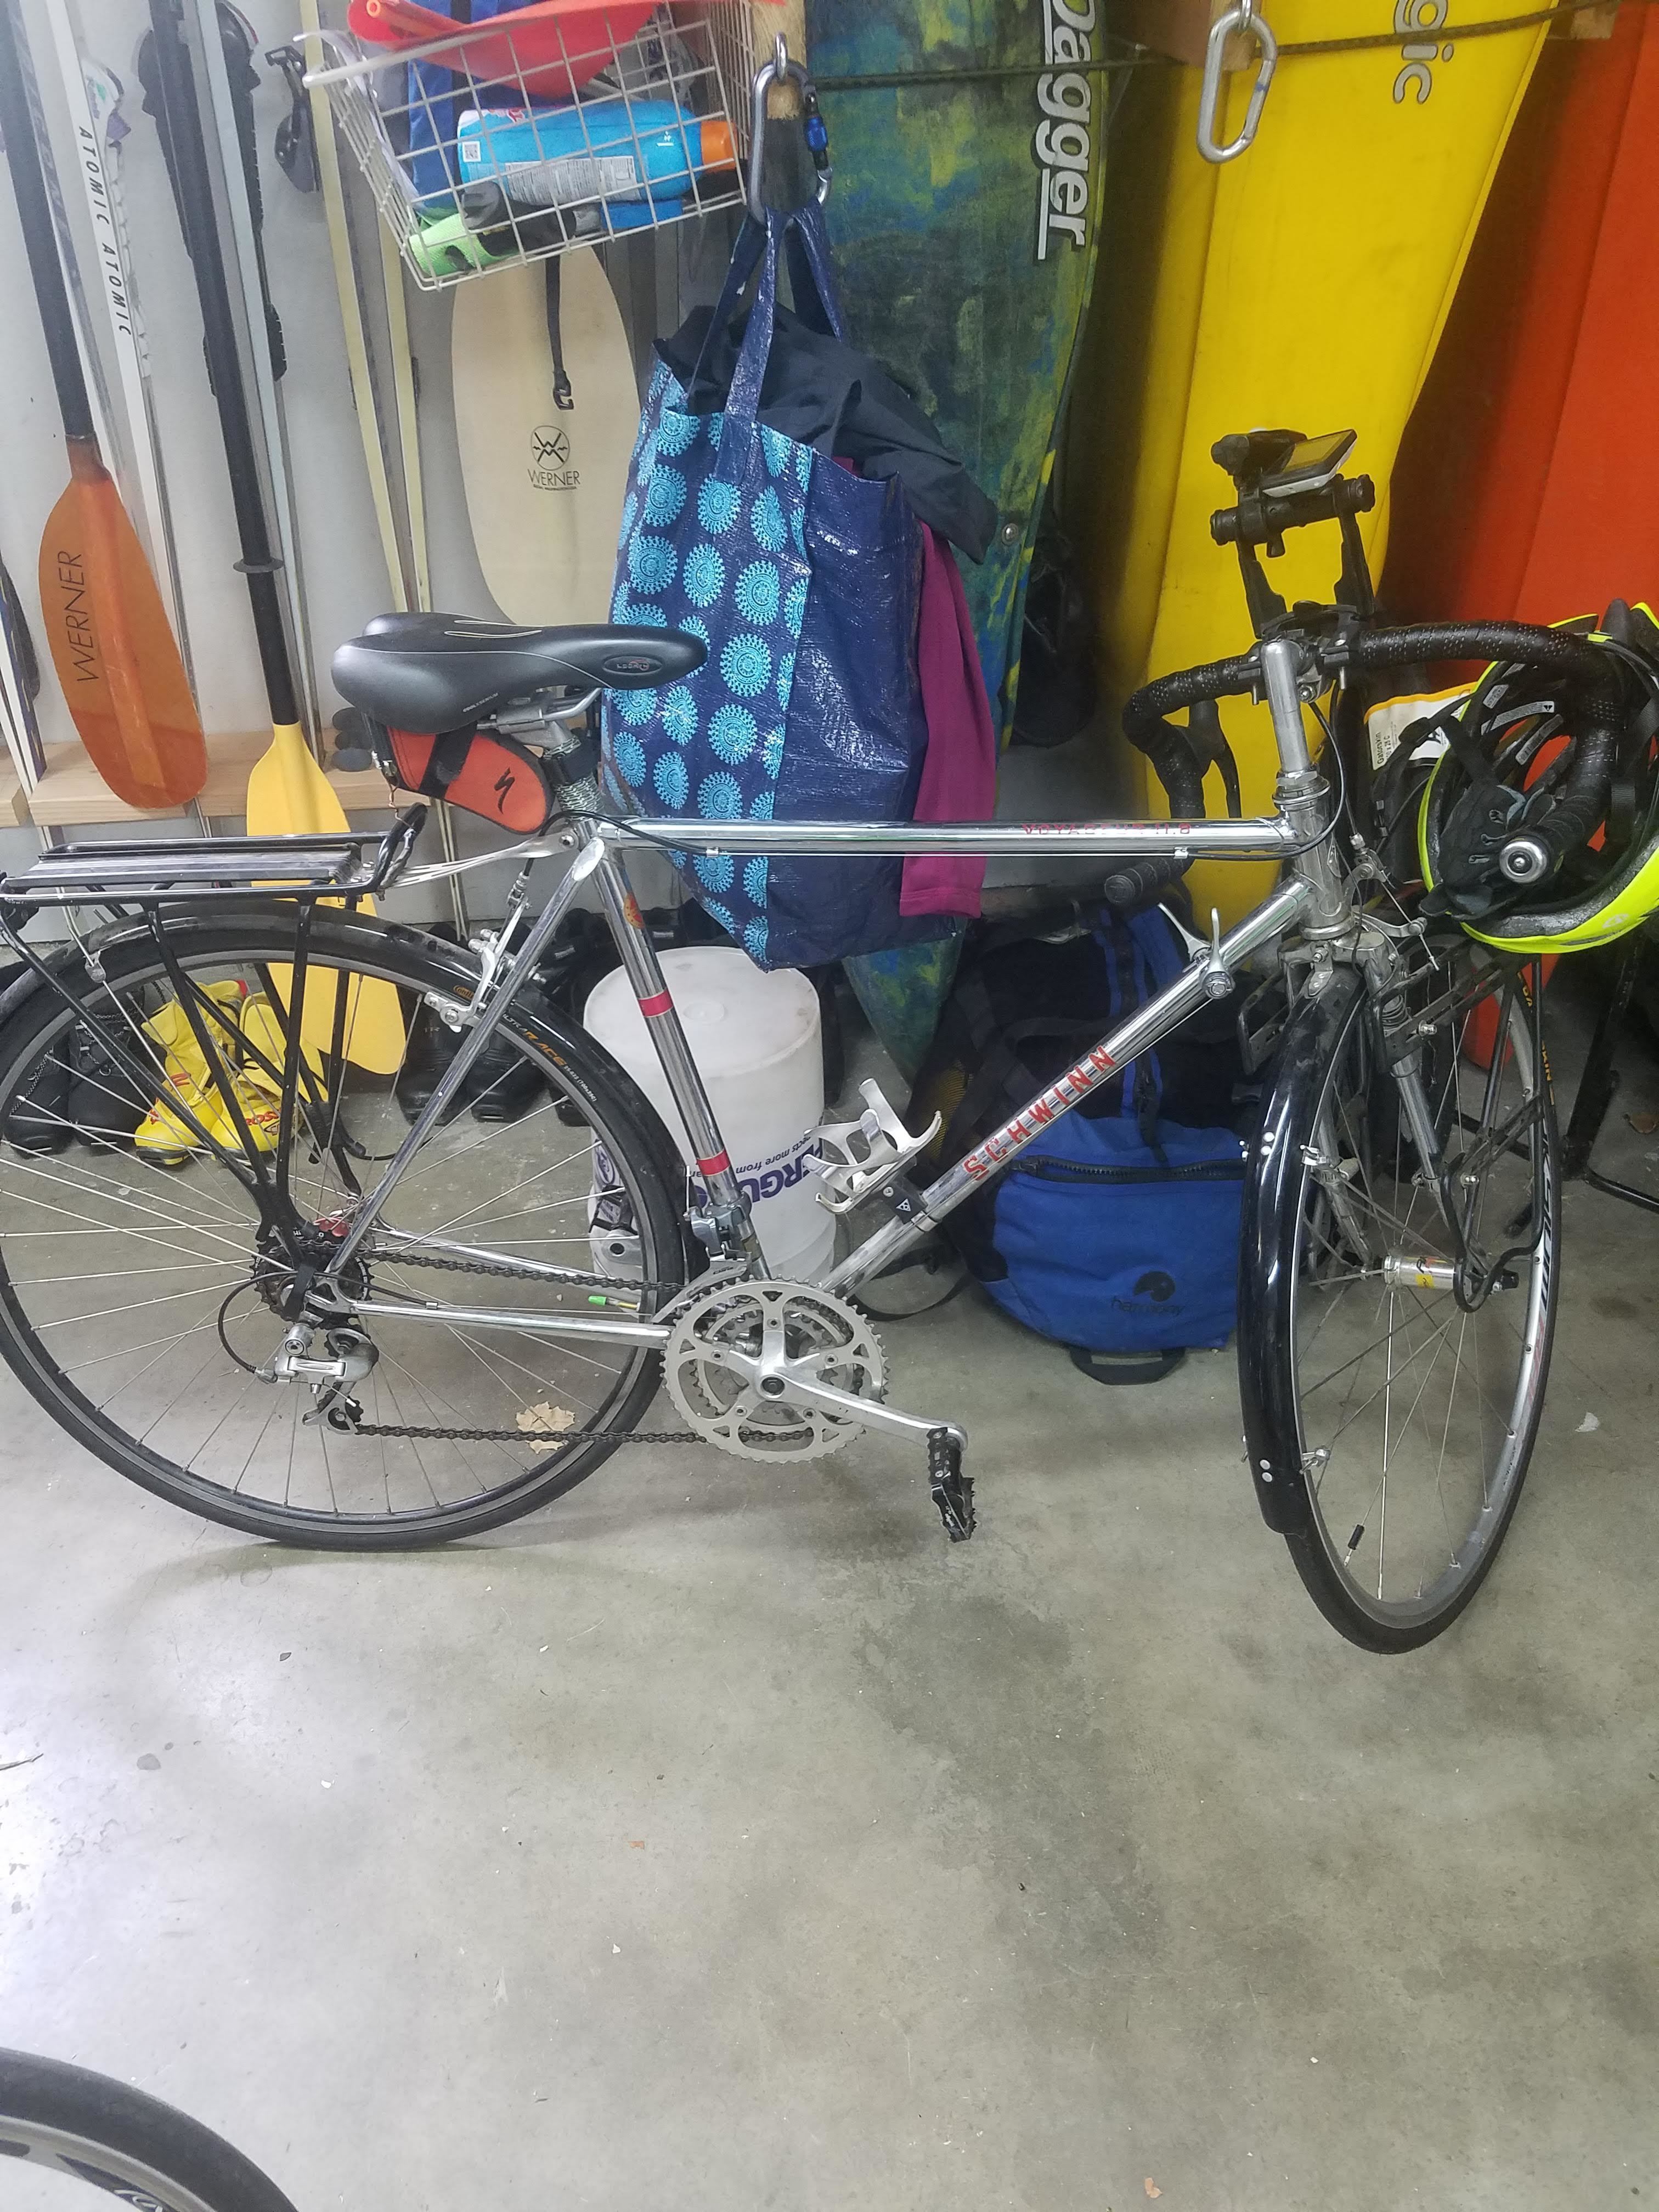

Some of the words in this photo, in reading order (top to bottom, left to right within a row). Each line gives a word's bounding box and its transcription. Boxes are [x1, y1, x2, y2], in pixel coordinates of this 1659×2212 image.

[1035, 0, 1096, 246] Dagger
[79, 126, 110, 225] ATOMIC
[102, 242, 131, 336] ATOMIC
[527, 469, 580, 486] WERNER
[57, 551, 99, 681] WERNER
[1375, 731, 1385, 765] Gatorskin
[523, 1031, 567, 1066] RACE
[963, 1045, 1116, 1180] SCHWINN
[736, 1162, 763, 1174] from
[765, 1149, 789, 1166] more
